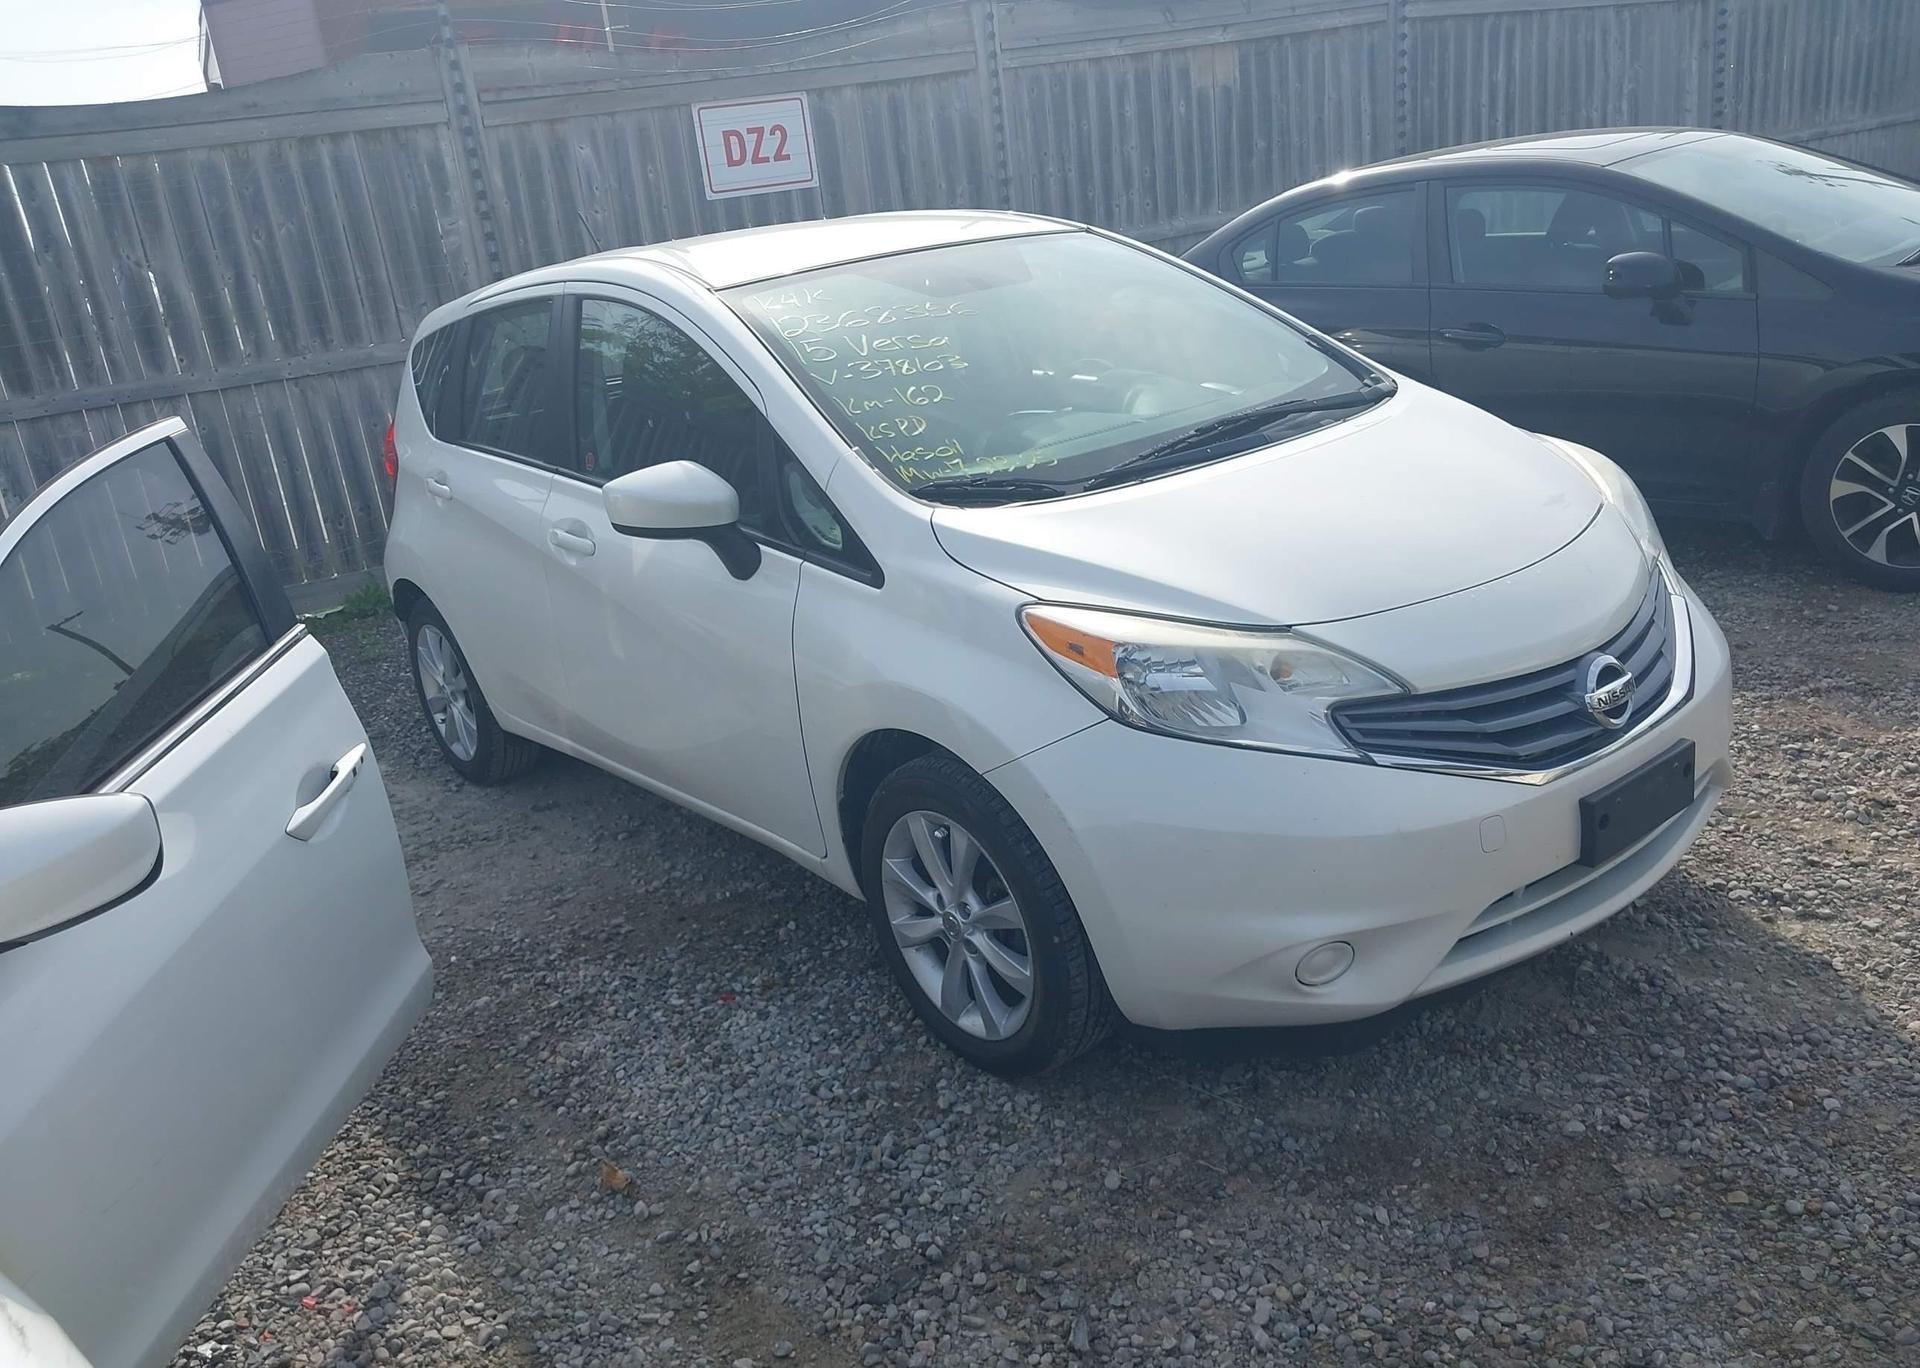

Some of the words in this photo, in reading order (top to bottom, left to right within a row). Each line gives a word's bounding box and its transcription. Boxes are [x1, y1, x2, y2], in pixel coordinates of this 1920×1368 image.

[721, 123, 791, 168] DZ2
[788, 337, 838, 365] 15
[843, 333, 951, 357] Versa
